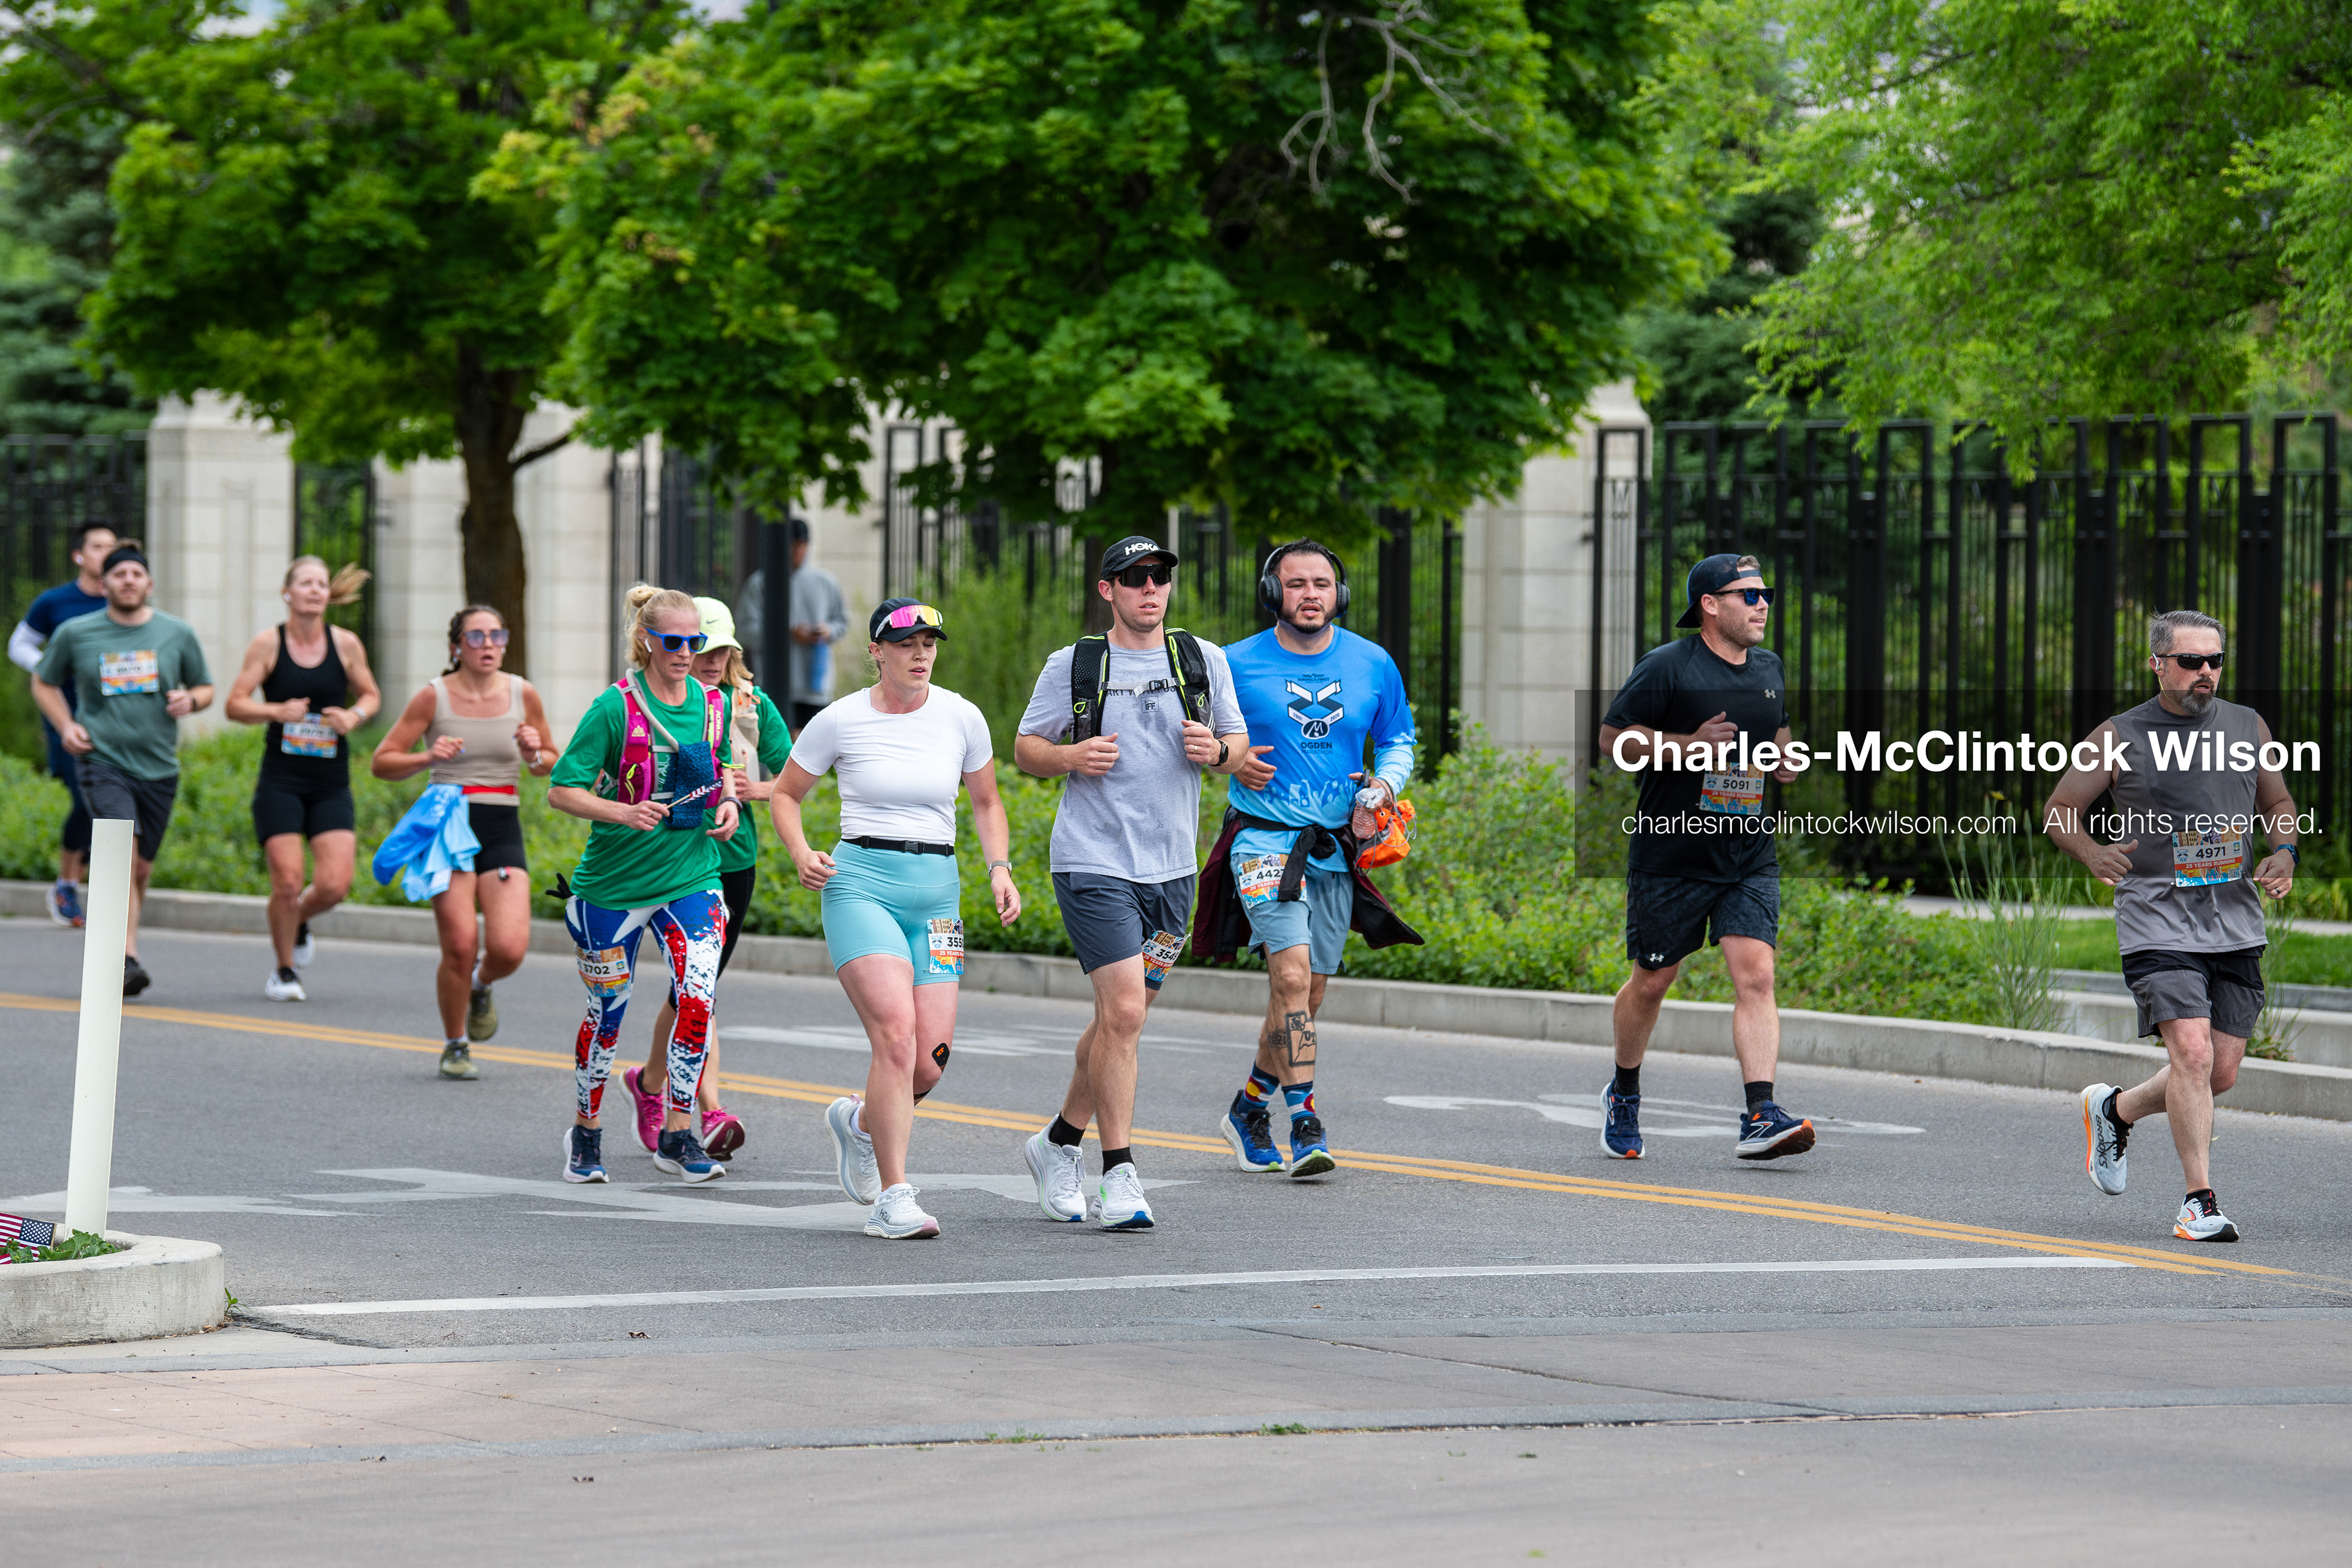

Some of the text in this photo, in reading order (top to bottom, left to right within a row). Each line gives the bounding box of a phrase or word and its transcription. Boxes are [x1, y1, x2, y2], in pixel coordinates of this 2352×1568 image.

[1125, 543, 1159, 556] HOKA
[1722, 779, 1749, 790] 5091
[2195, 846, 2226, 859] 4971
[1150, 957, 1164, 966] YEARS
[583, 963, 610, 975] 3702
[2095, 1114, 2108, 1168] BROOKS
